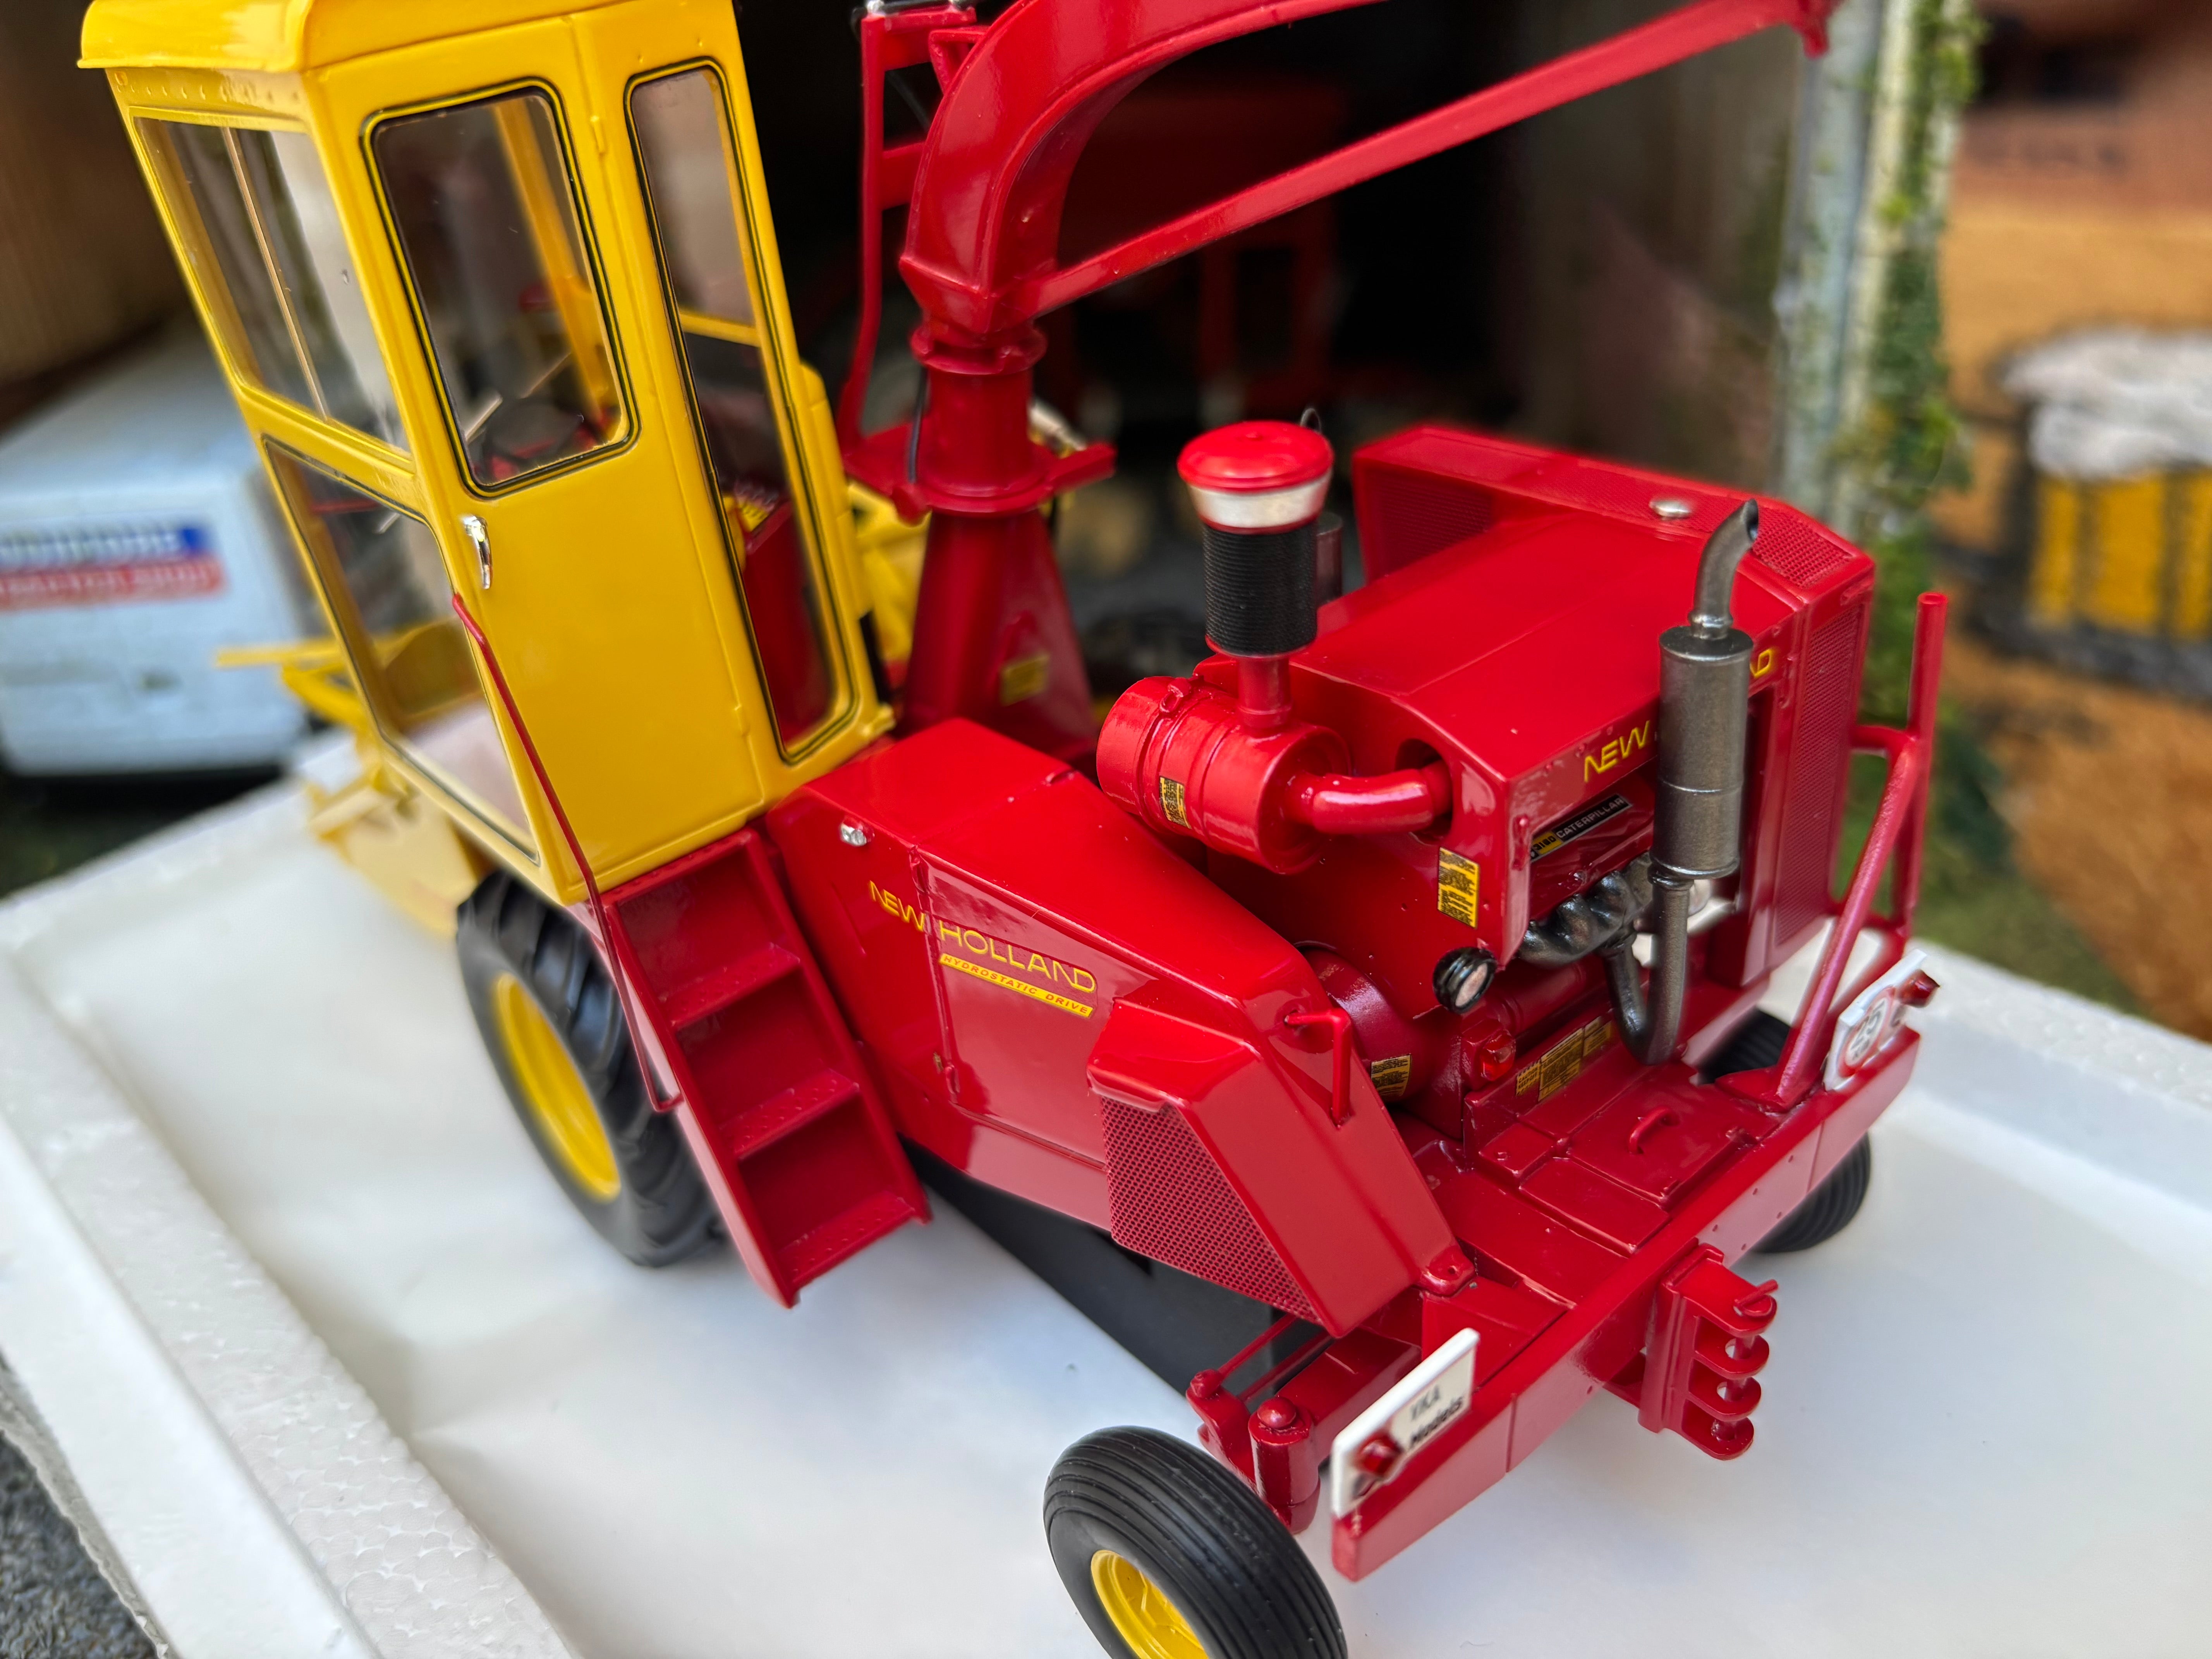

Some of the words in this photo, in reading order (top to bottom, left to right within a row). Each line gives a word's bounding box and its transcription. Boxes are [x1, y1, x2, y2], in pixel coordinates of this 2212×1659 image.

[1584, 720, 1650, 783] NEW
[1556, 797, 1625, 838] CATERPILLAR
[869, 880, 926, 932] NEW
[939, 920, 1096, 993] HOLLAND
[944, 955, 1037, 994] HYDROSTATIC
[1045, 993, 1088, 1014] DRIVE
